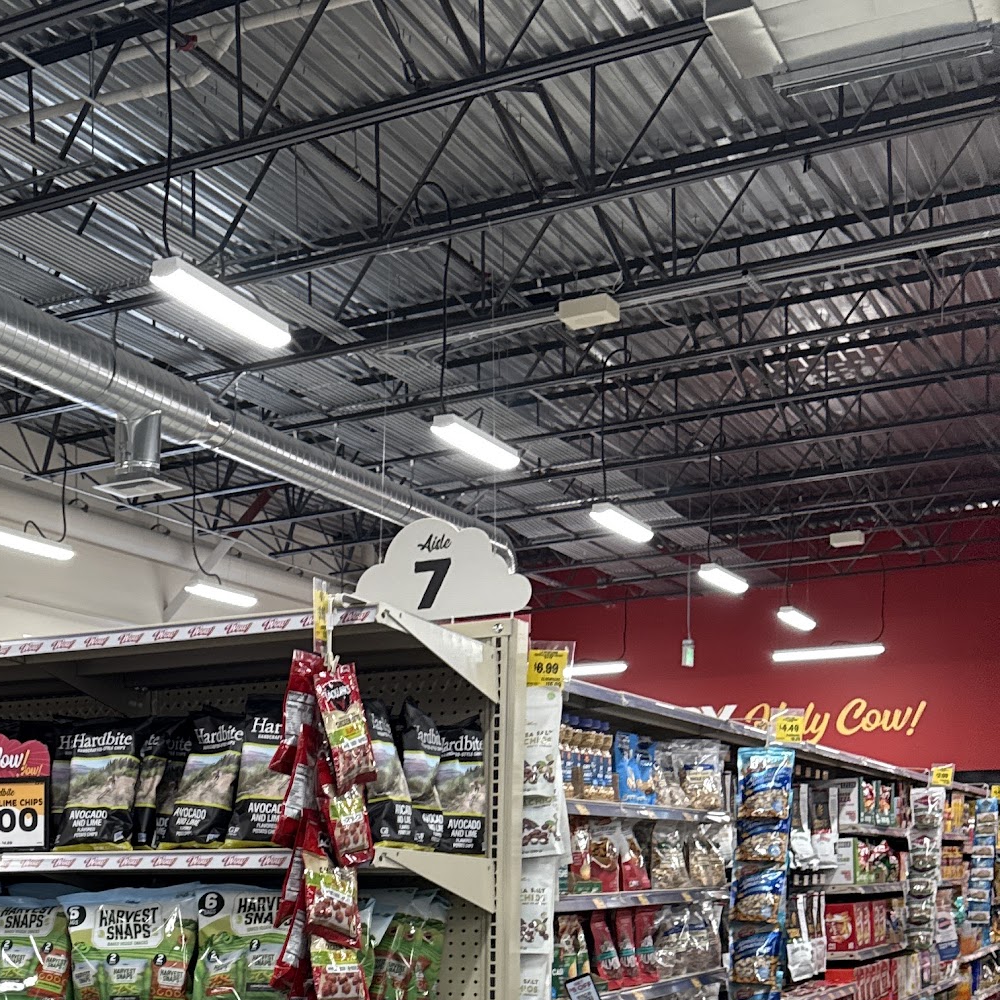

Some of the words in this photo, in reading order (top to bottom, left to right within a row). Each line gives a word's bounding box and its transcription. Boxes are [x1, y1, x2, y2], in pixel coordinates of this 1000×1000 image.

[418, 534, 451, 552] Aisle
[414, 558, 451, 610] 7
[836, 698, 927, 736] Cow!
[73, 731, 132, 748] Hardbite
[70, 810, 107, 820] AVOCADO
[448, 819, 481, 830] AVOCADO
[204, 893, 218, 909] 6
[4, 914, 45, 929] SNAPS
[100, 907, 158, 927] HARVEST
[106, 924, 151, 940] SNAPS
